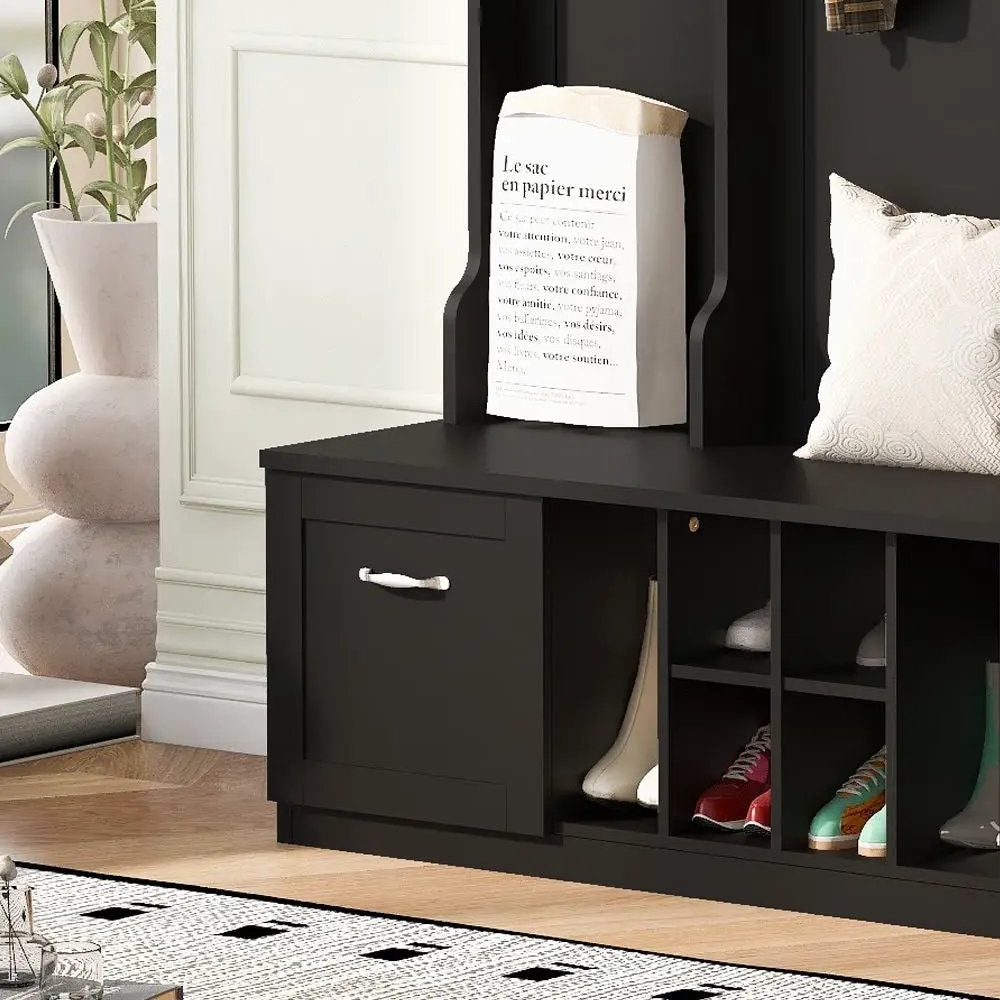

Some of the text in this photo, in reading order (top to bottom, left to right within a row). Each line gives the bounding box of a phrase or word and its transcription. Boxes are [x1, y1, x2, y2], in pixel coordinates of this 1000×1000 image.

[502, 155, 549, 176] Le sac
[501, 178, 627, 203] en papier merci
[557, 252, 586, 262] votre
[542, 285, 569, 295] votre
[571, 285, 623, 301] confiance,
[498, 297, 520, 306] votre
[564, 320, 581, 328] vos
[543, 352, 570, 362] votre
